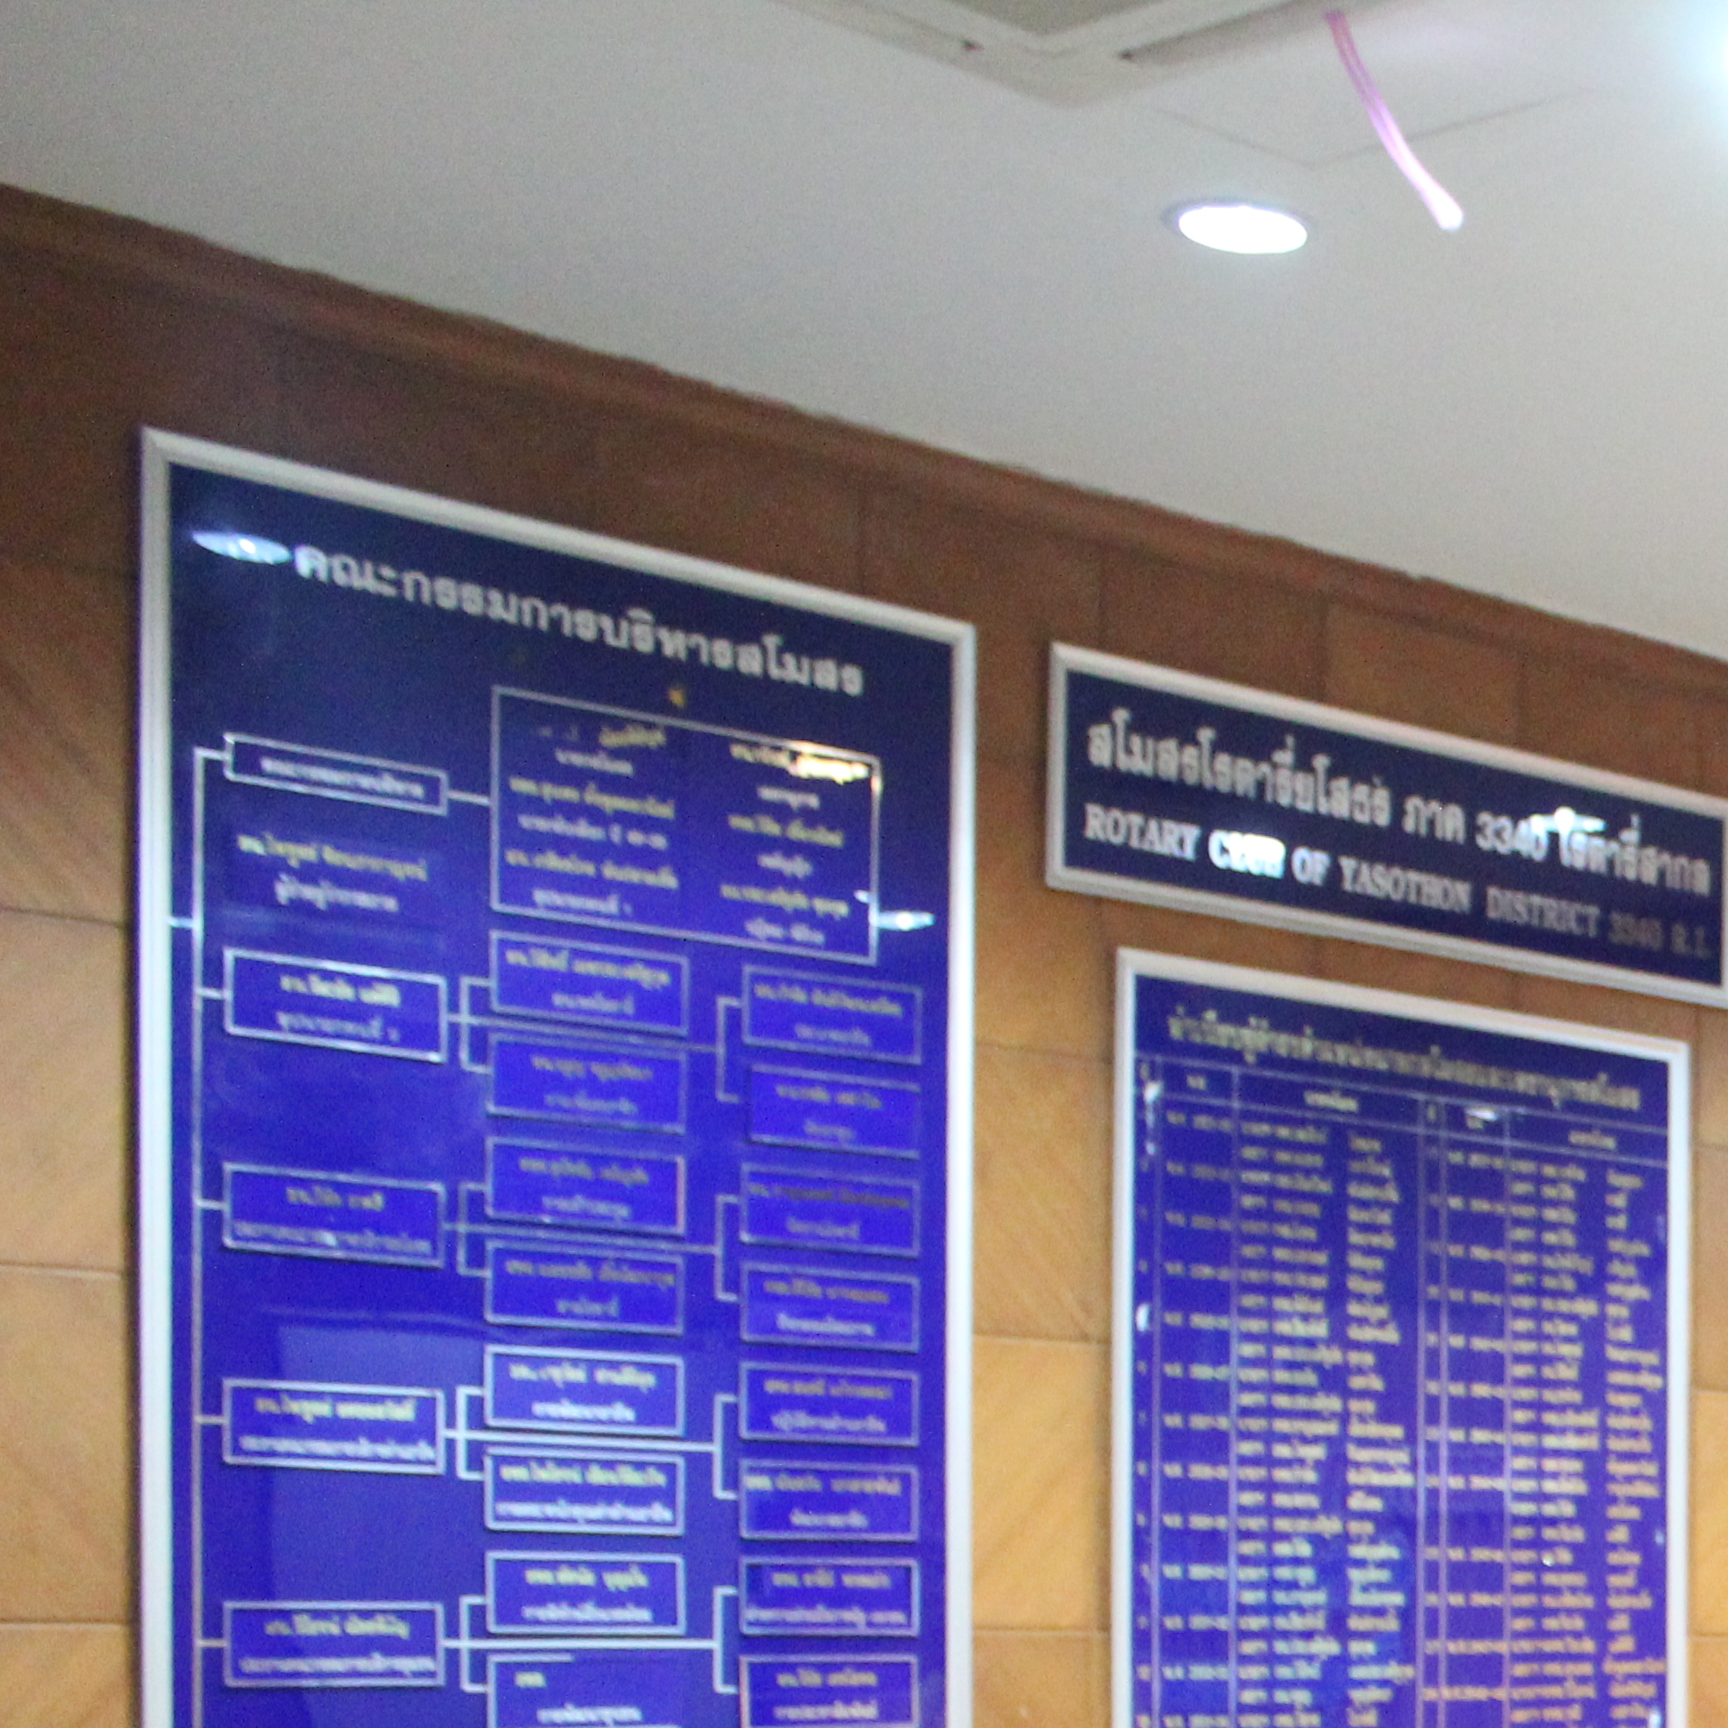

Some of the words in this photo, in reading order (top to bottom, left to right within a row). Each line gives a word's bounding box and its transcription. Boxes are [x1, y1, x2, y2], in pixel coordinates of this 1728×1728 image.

[295, 544, 864, 697] คณะกรรมการบริหารสโมสร
[1084, 803, 1201, 860] ROTARY
[1292, 846, 1334, 888] OF
[1339, 856, 1472, 914] YASOTHON
[1486, 886, 1600, 938] DISTRICT
[1403, 795, 1465, 844] ภาค
